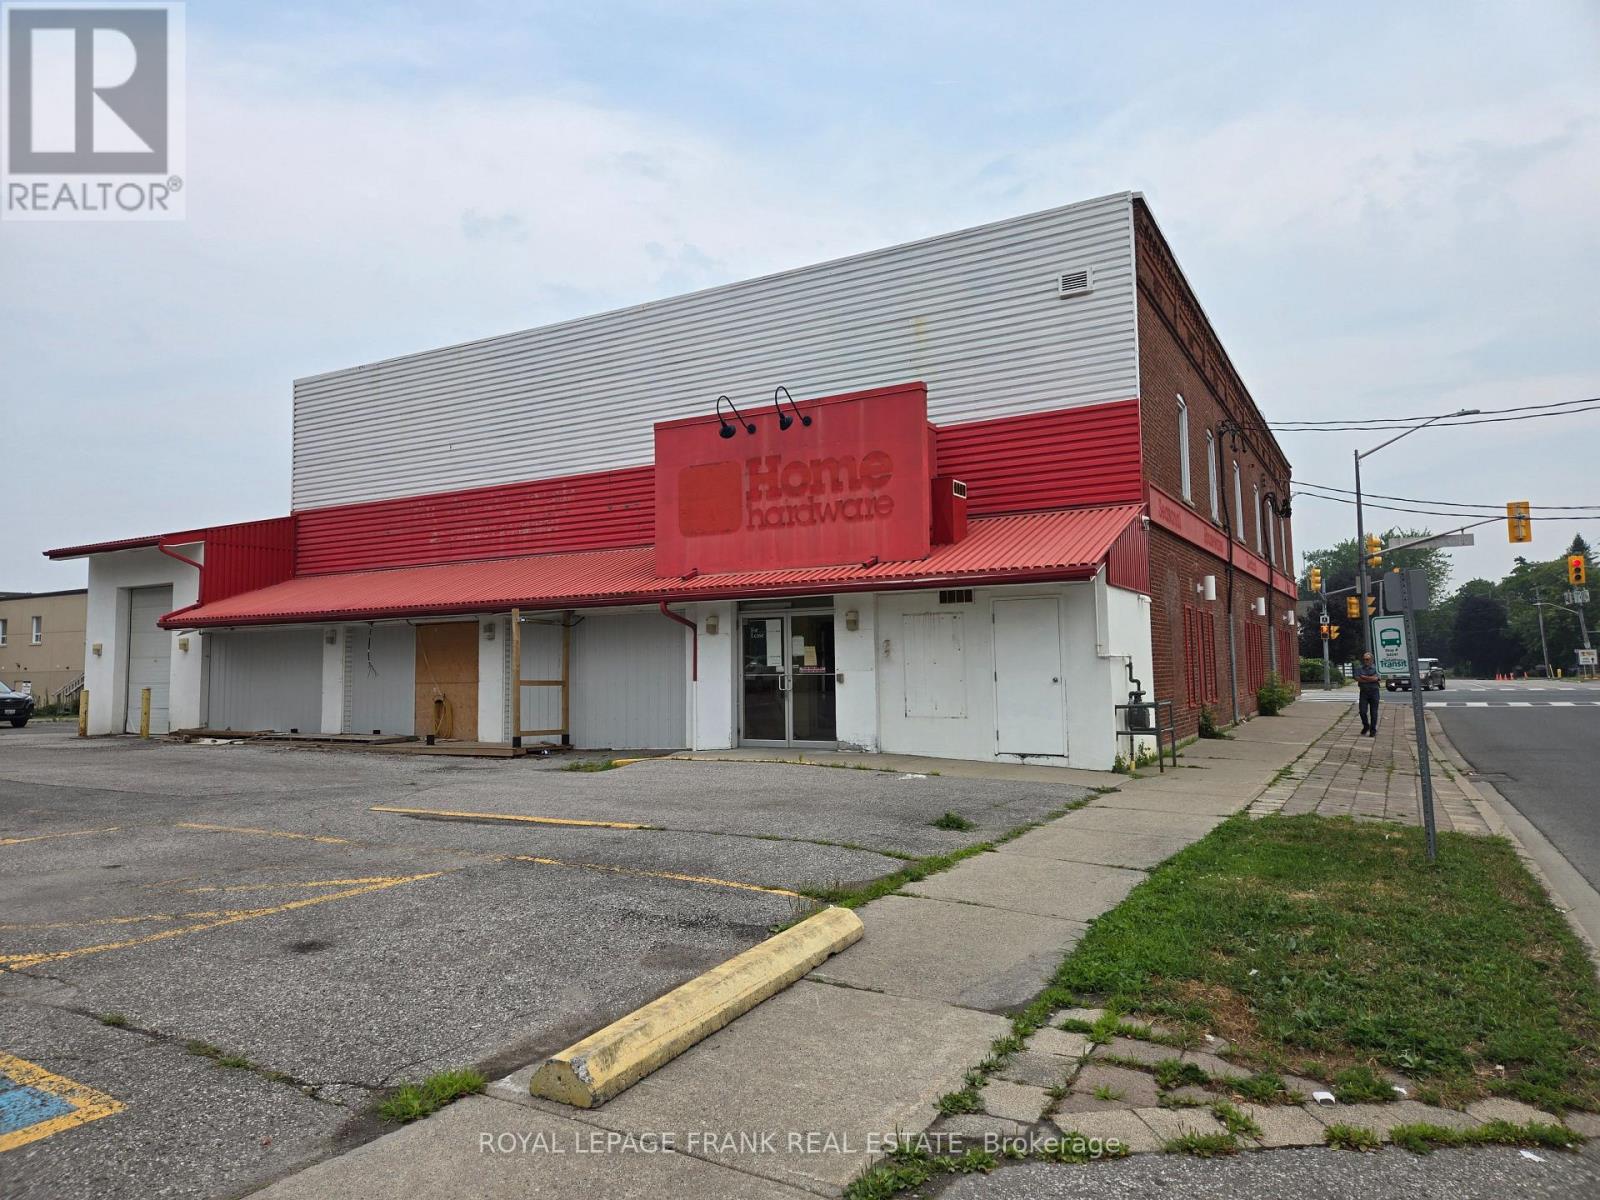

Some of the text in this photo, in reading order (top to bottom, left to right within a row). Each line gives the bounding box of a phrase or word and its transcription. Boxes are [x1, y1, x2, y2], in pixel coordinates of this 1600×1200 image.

[745, 450, 894, 500] Home
[745, 494, 895, 531] hardware
[1379, 660, 1408, 668] Transit
